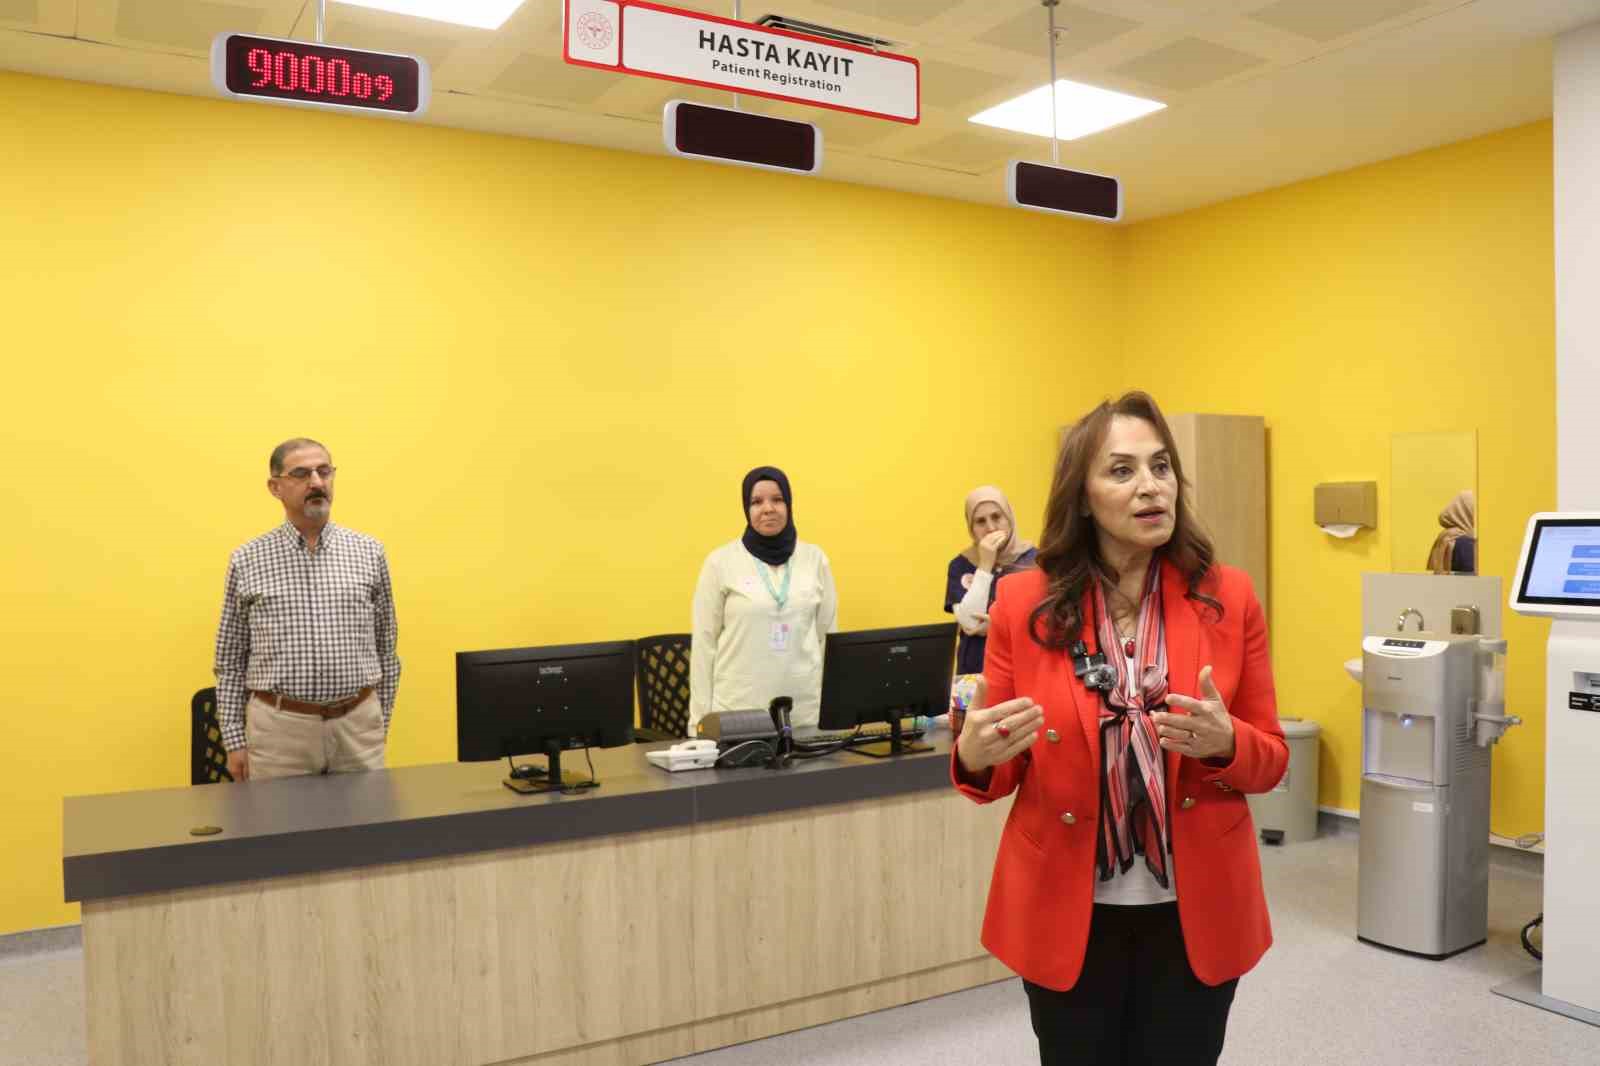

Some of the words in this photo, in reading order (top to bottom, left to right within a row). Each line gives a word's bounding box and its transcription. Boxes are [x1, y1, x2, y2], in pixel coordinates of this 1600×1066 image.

[698, 29, 780, 64] HASTA
[787, 46, 854, 77] KAYIT
[712, 58, 761, 79] Patient
[763, 69, 842, 93] Registration
